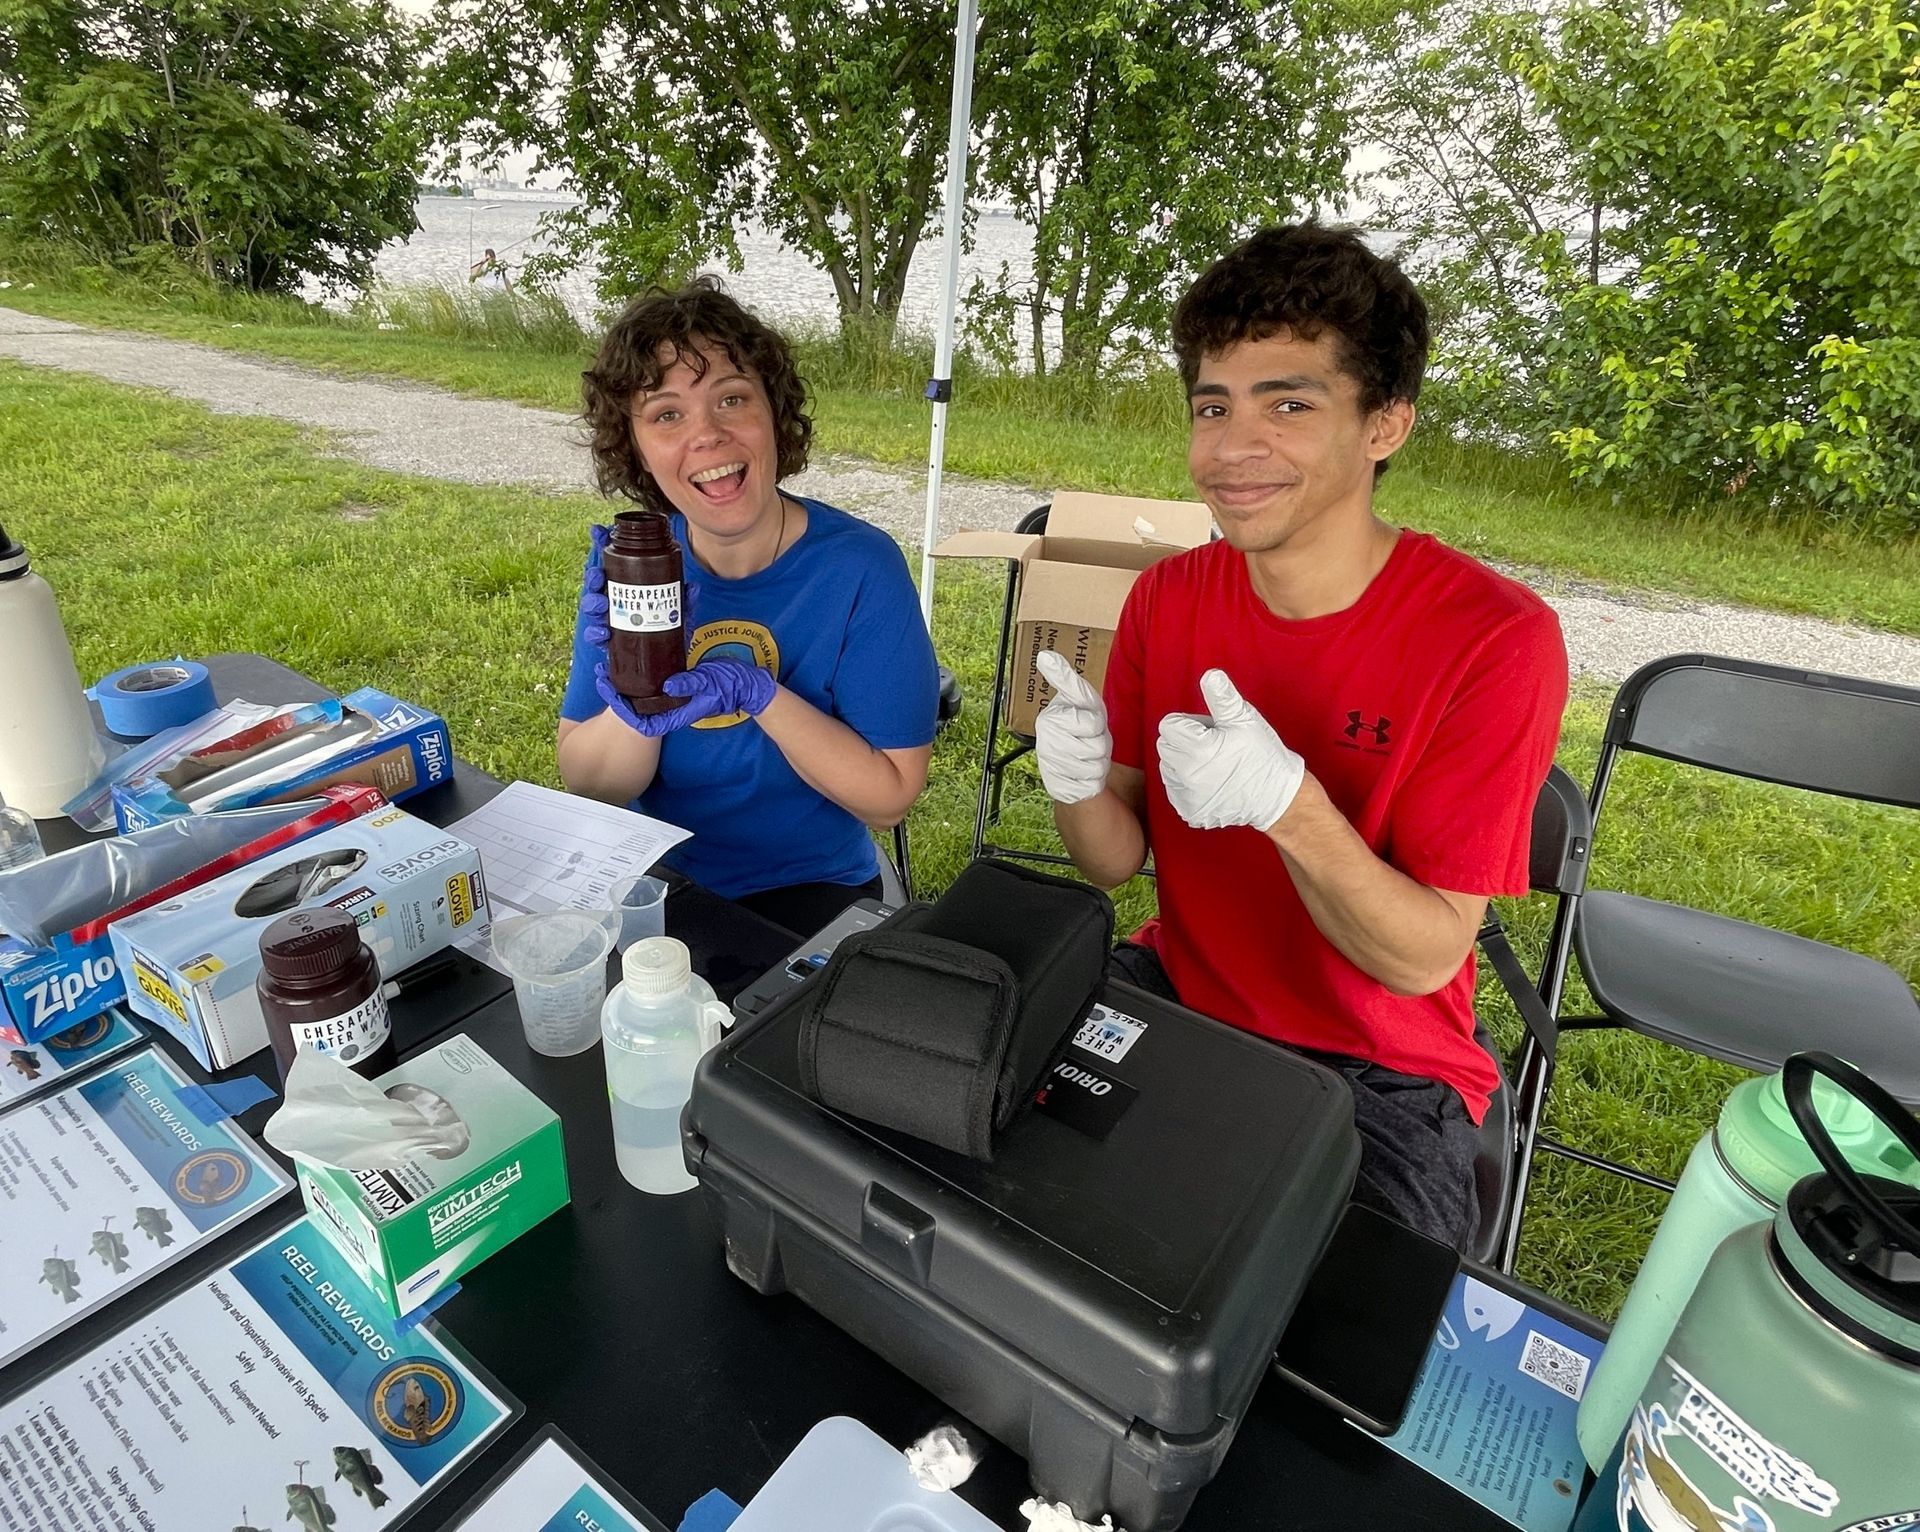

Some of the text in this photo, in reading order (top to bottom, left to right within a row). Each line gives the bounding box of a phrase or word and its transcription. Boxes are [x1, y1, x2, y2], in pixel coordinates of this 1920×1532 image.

[612, 586, 677, 600] CHESAPEAKE
[612, 598, 641, 611] WATER
[703, 626, 739, 640] JUSTICE
[420, 732, 444, 781] Ziploc
[366, 791, 380, 803] 12
[371, 812, 403, 828] 200
[381, 840, 458, 879] GLOVES
[412, 901, 423, 924] Sizing
[448, 878, 465, 926] GLOVES
[284, 926, 345, 952] NALGENE
[24, 955, 120, 1028] Ziplo
[305, 1030, 354, 1051] ATER
[1053, 1062, 1113, 1096] ORIO
[123, 1071, 152, 1100] REEL
[148, 1098, 203, 1154] REWARDS
[429, 1161, 520, 1226] KIMTECH
[282, 1245, 394, 1359] REEL REWARDS
[163, 1336, 177, 1352] sharp
[207, 1281, 328, 1422] Handling and Dispatching Invasive Fish Species
[138, 1353, 155, 1371] source
[151, 1344, 165, 1360] sharp
[162, 1357, 177, 1373] knife
[174, 1350, 188, 1365] spike
[185, 1364, 194, 1372] or
[235, 1350, 255, 1373] Safely
[109, 1362, 126, 1382] Mallet
[151, 1370, 162, 1378] of
[189, 1369, 201, 1381] flat
[97, 1370, 123, 1407] Work gloves
[156, 1376, 170, 1392] clean
[196, 1378, 213, 1394] head
[83, 1379, 99, 1401] Strong
[95, 1397, 107, 1410] flat
[102, 1408, 119, 1430] surface
[121, 1355, 132, 1365] An
[145, 1387, 161, 1405] cooler
[158, 1403, 174, 1420] filled
[169, 1419, 182, 1434] with
[177, 1431, 188, 1442] ice
[168, 1390, 182, 1406] water
[207, 1393, 235, 1425] screwdriver
[229, 1379, 280, 1439] Equipment Needed
[29, 1414, 46, 1437] Locate
[42, 1435, 53, 1448] the
[1469, 1425, 1480, 1434] by
[1464, 1434, 1477, 1450] help
[43, 1405, 64, 1431] Control
[58, 1429, 68, 1441] the
[74, 1454, 91, 1478] Secure
[100, 1495, 114, 1511] fish
[108, 1509, 119, 1521] on
[1462, 1450, 1470, 1463] can
[1454, 1463, 1466, 1478] You
[107, 1466, 140, 1512] Step-by-Step
